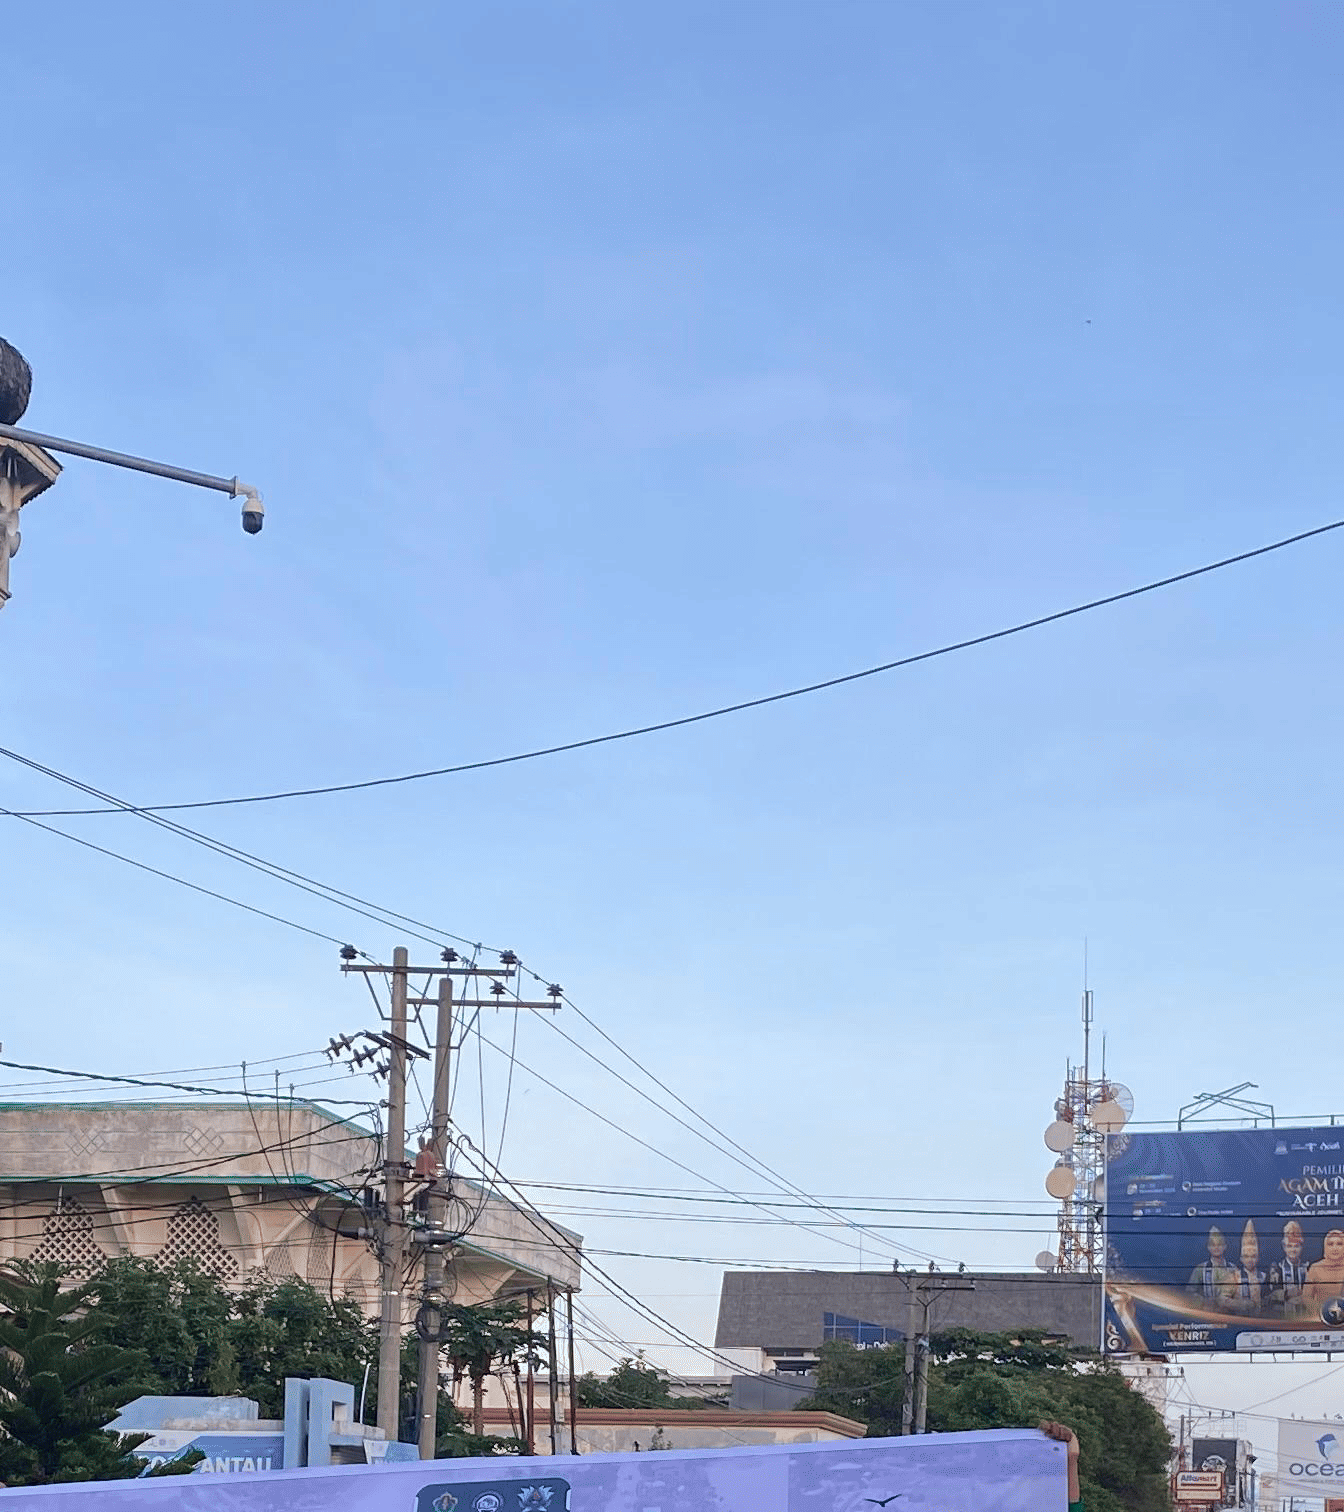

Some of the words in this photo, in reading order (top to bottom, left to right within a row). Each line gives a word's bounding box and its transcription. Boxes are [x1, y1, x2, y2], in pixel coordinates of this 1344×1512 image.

[1278, 1176, 1330, 1194] AGAM
[1292, 1193, 1340, 1210] ACEH
[199, 1455, 273, 1473] ANTAU
